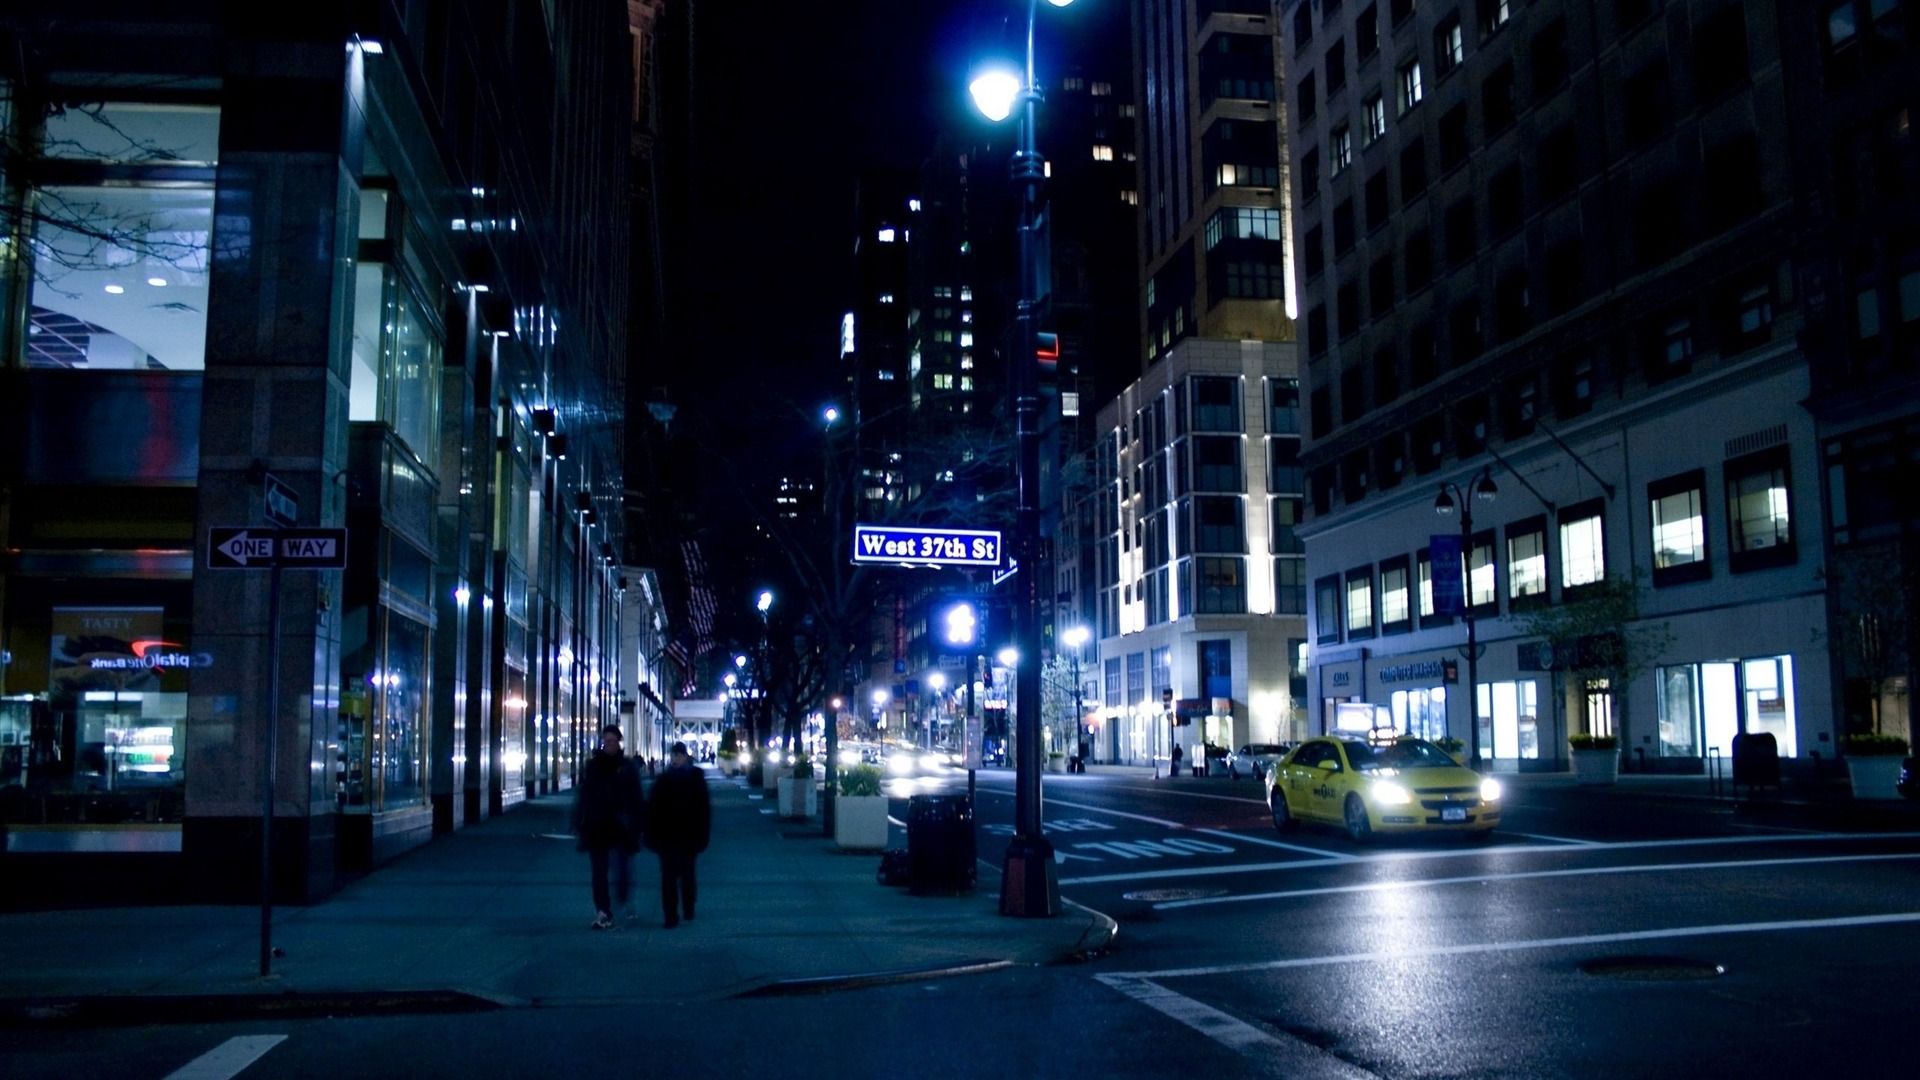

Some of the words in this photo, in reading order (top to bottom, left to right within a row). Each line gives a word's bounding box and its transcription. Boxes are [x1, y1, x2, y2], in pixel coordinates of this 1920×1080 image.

[231, 540, 269, 556] ONE
[288, 540, 328, 556] WAY
[862, 534, 916, 557] West
[920, 536, 967, 558] 37th
[972, 538, 995, 559] St
[81, 617, 132, 628] TASTY
